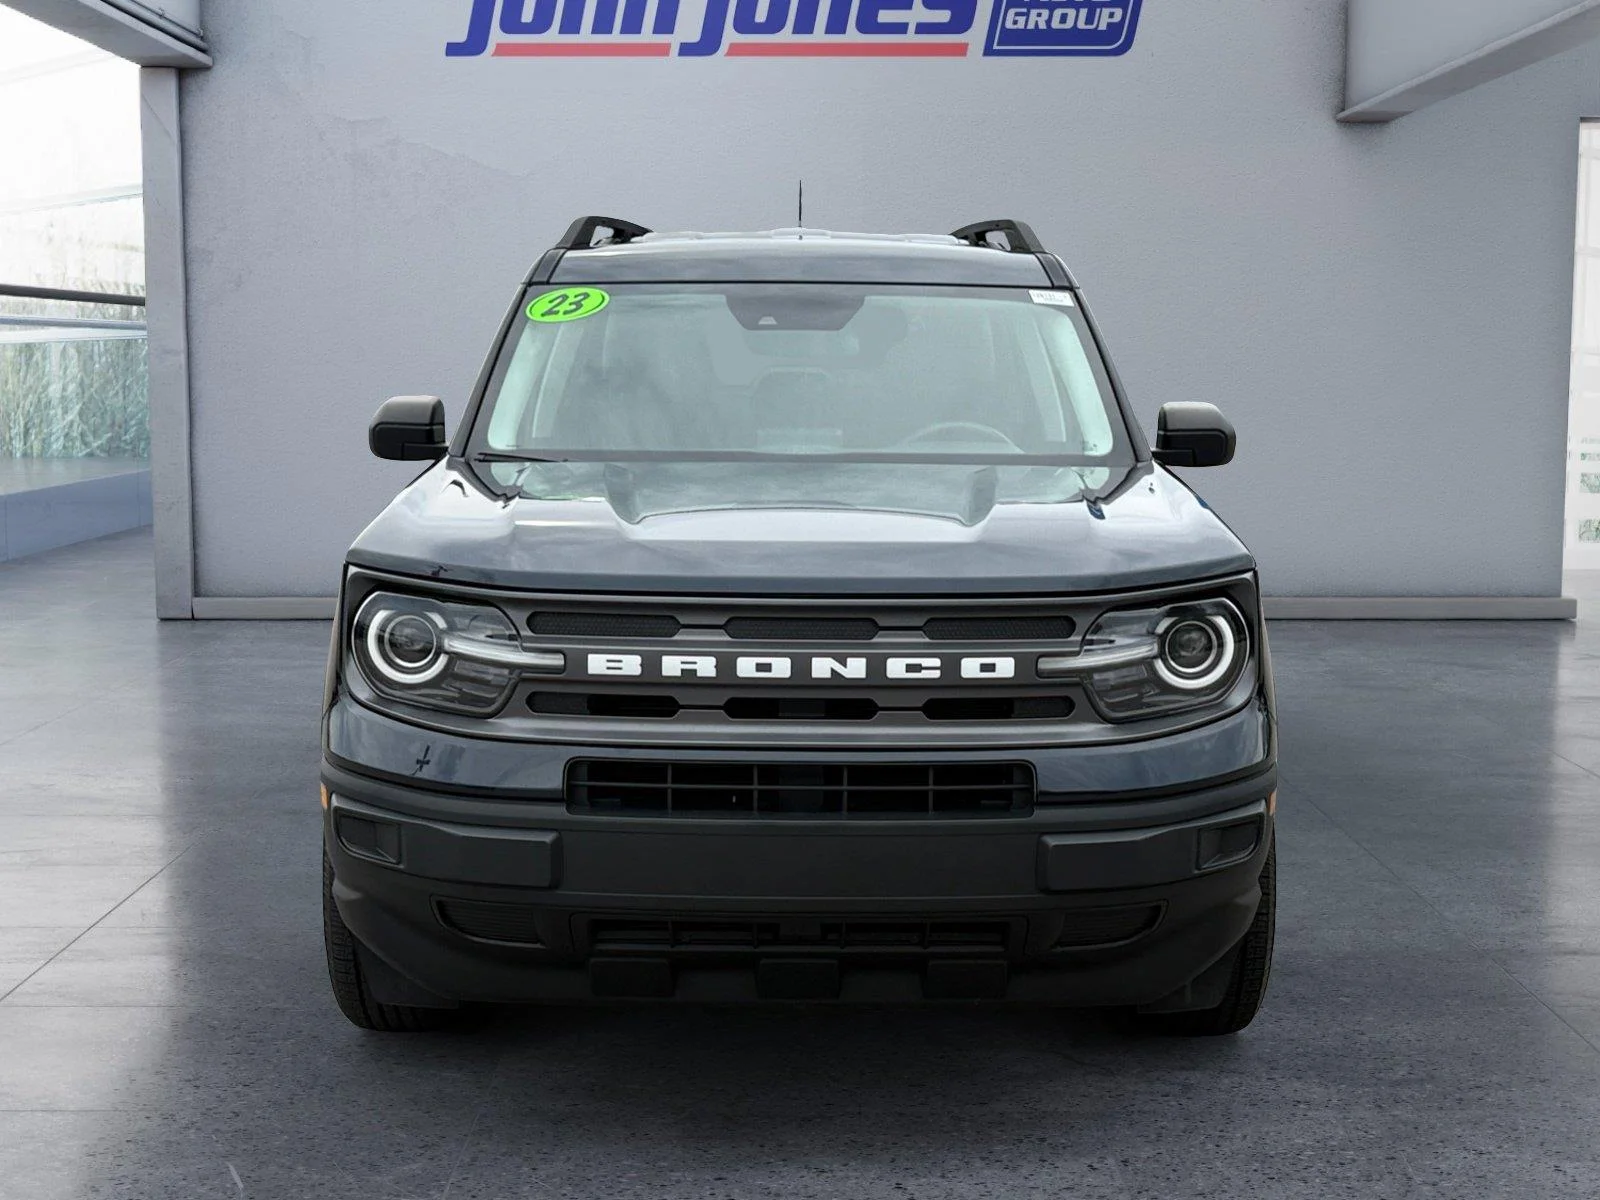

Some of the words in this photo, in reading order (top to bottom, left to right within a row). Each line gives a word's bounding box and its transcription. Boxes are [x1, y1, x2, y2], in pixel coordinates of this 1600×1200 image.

[1004, 7, 1123, 30] GROUP
[541, 292, 590, 317] 23
[587, 653, 1016, 679] BRONCO
